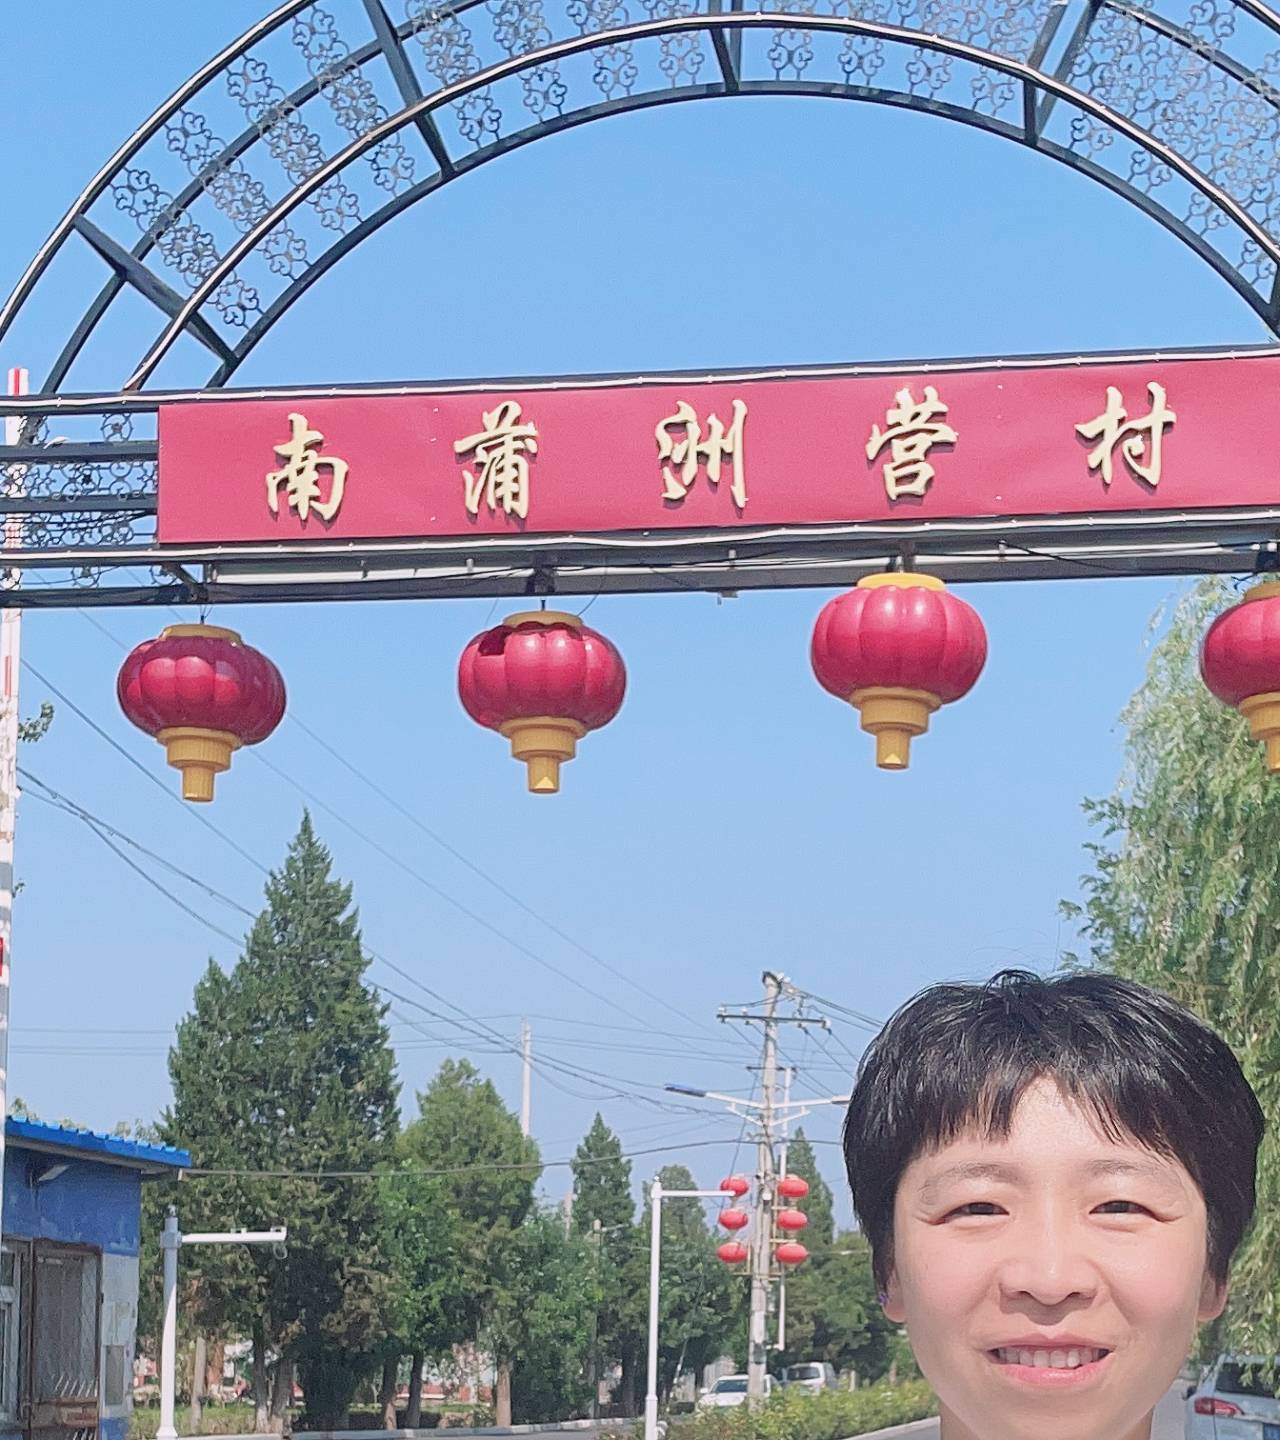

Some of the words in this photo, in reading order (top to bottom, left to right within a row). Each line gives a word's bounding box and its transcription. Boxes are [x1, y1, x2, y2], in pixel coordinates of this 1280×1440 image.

[265, 381, 1178, 522] 南蒲洲营村
